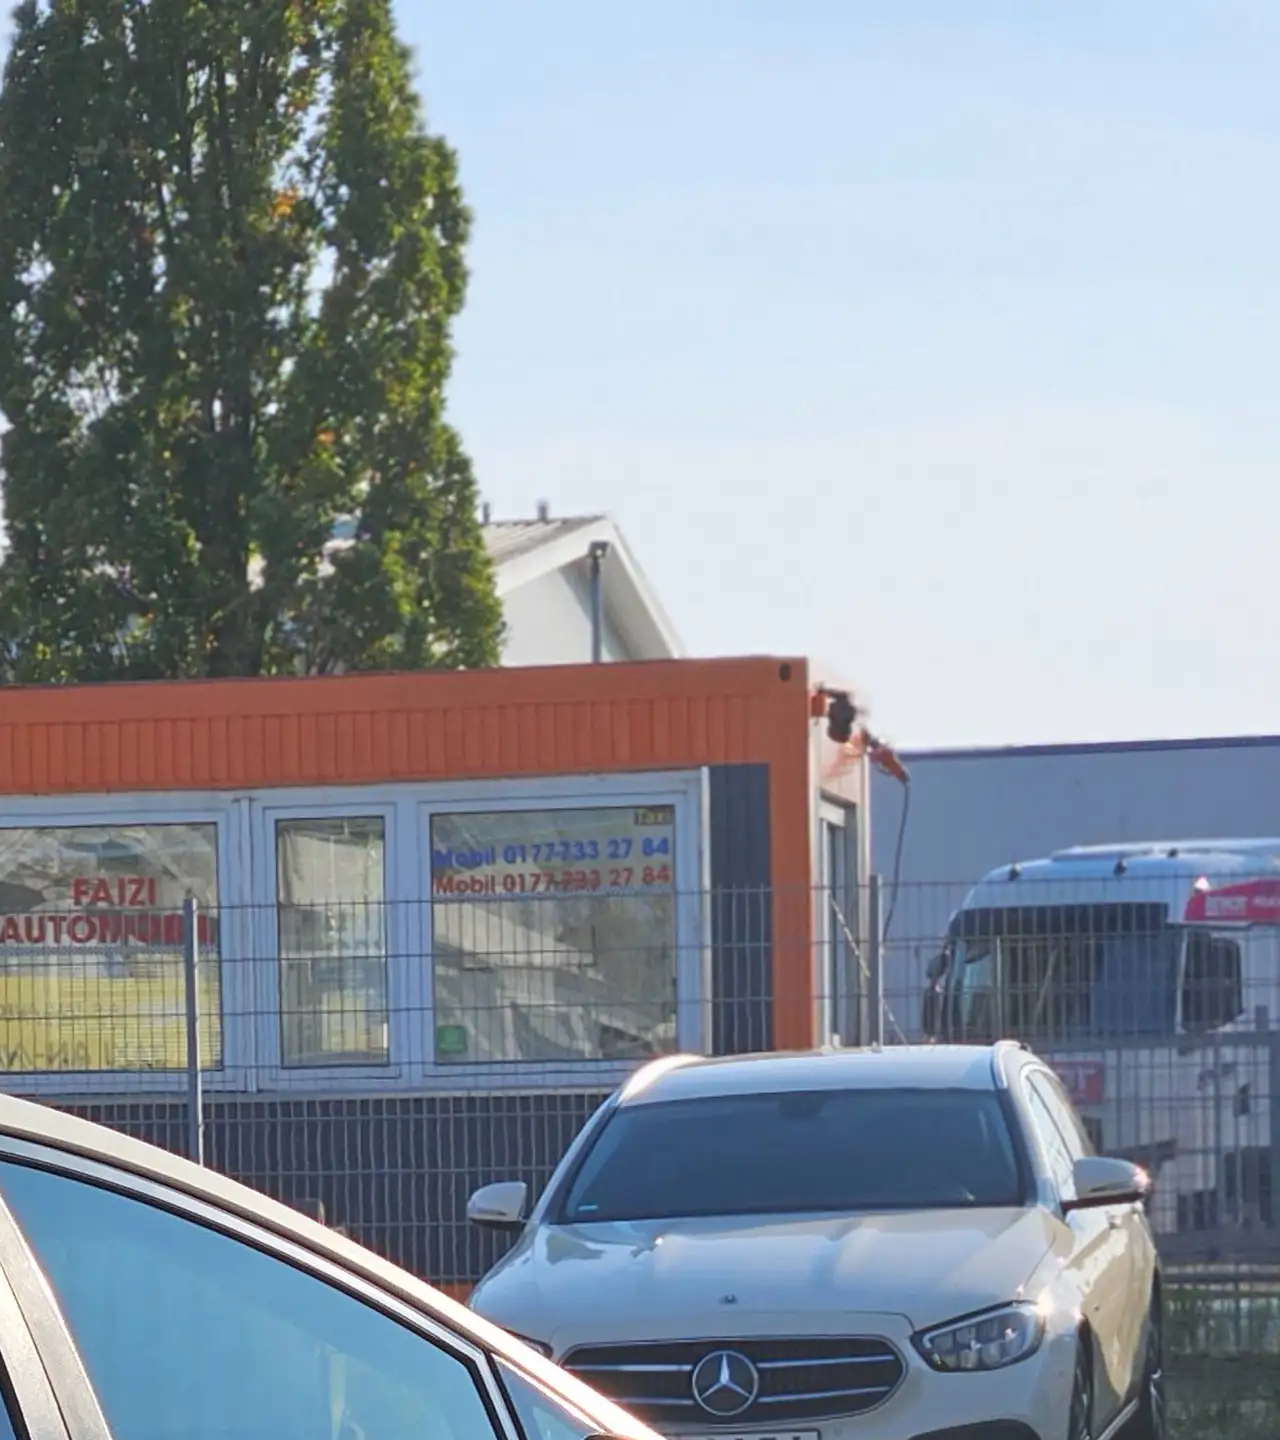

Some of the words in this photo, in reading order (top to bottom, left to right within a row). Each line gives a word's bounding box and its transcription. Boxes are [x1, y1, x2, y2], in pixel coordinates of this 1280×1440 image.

[607, 837, 634, 860] 27
[72, 877, 156, 906] FAIZI
[434, 870, 496, 894] Mobil
[609, 867, 635, 887] 27
